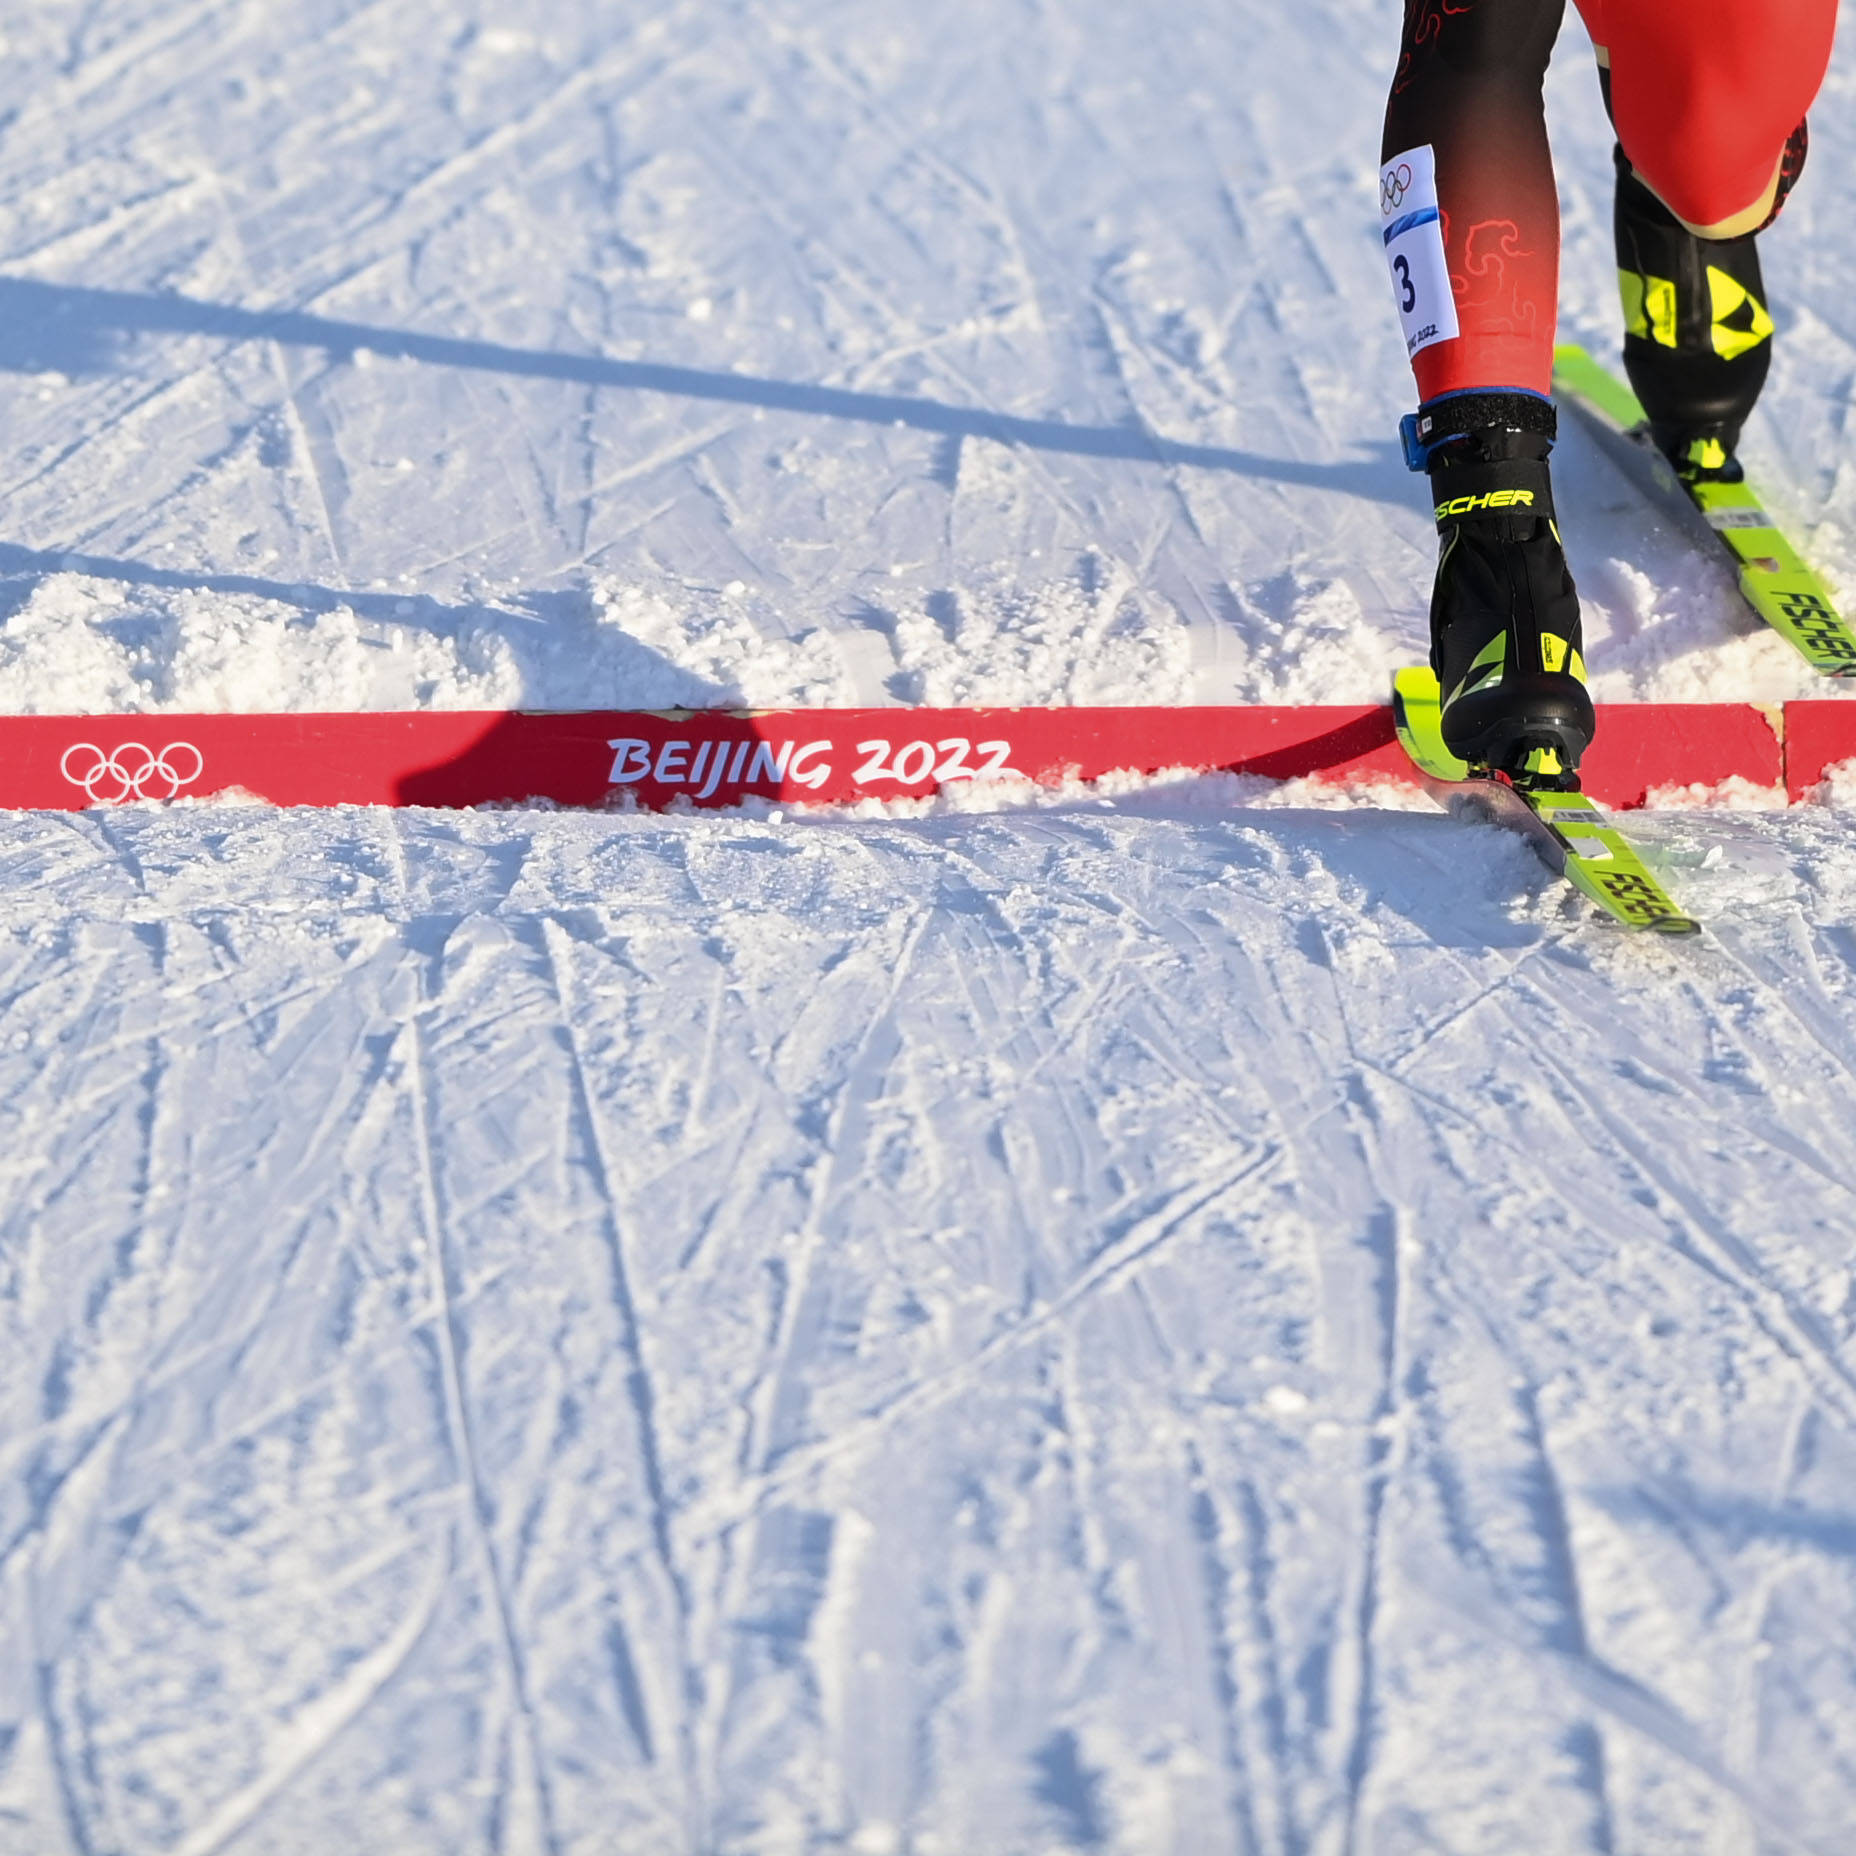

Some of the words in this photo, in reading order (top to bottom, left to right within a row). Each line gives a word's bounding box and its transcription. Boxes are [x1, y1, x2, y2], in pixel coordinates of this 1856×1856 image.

[1392, 253, 1417, 314] 3
[1434, 488, 1535, 522] SCHER
[607, 738, 833, 800] BEIJING
[851, 737, 1028, 785] 2022
